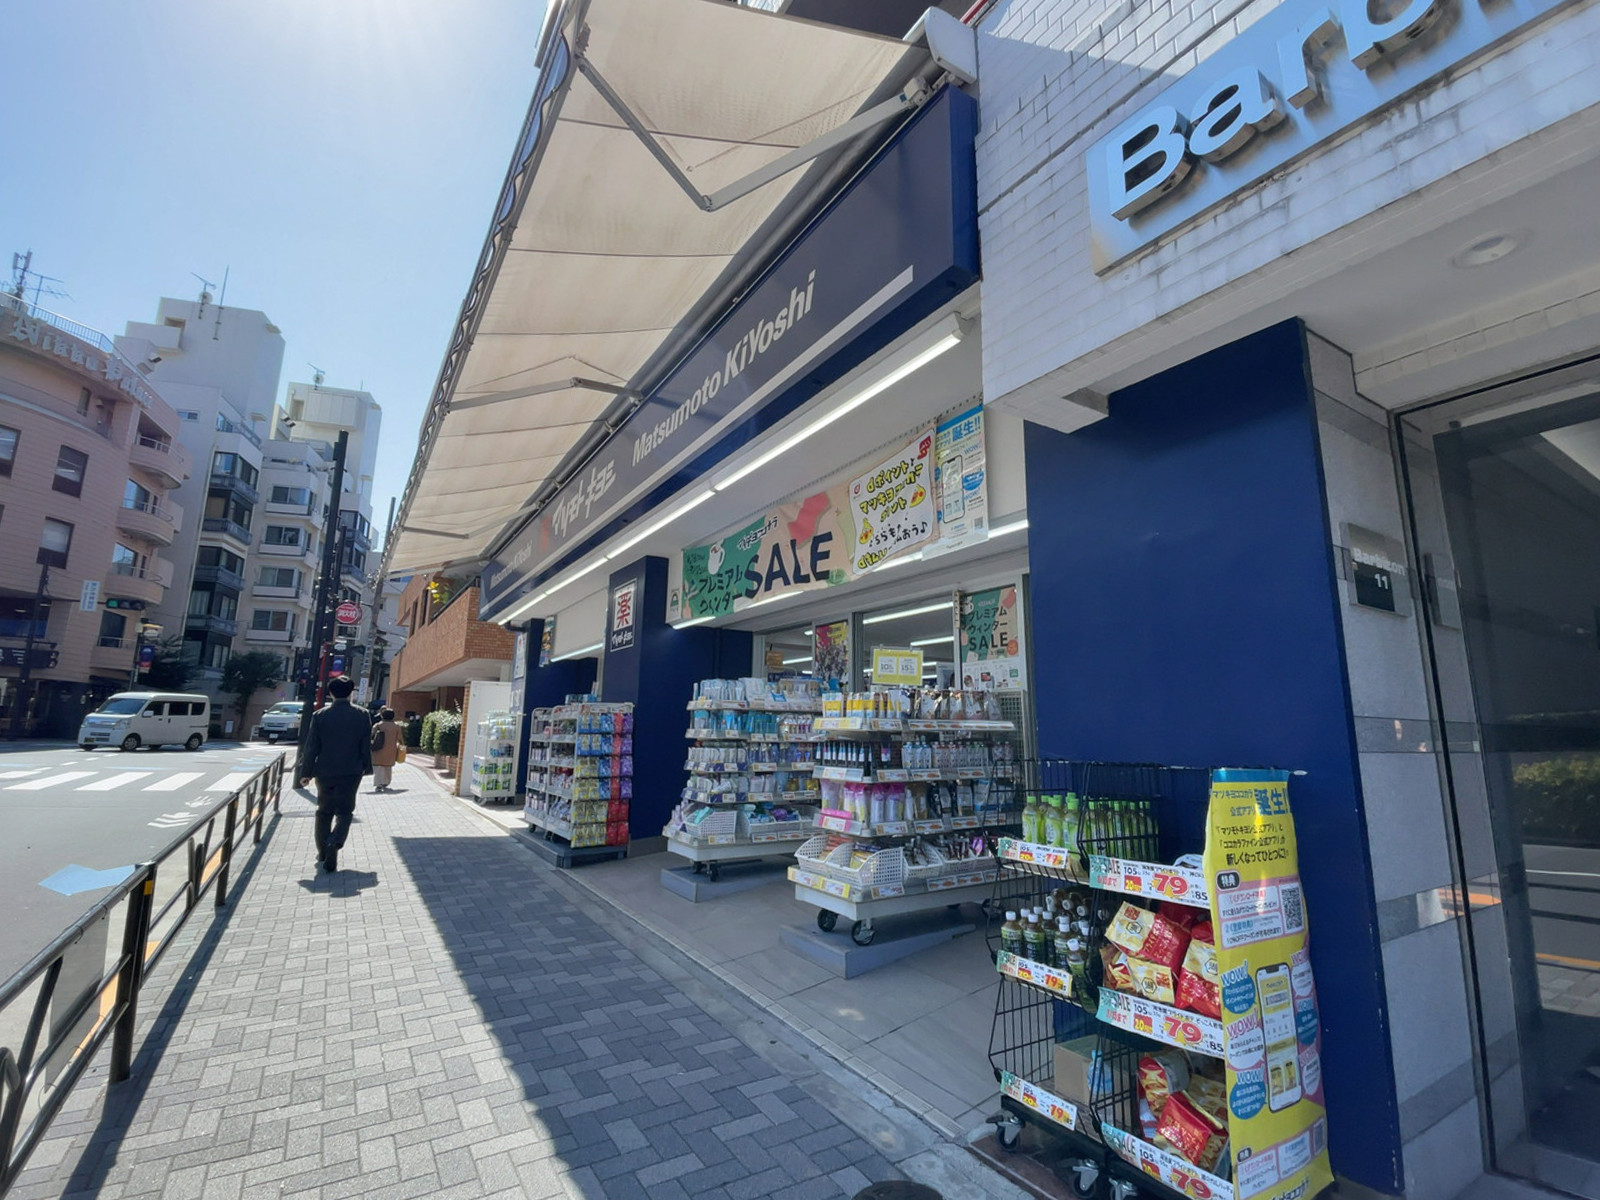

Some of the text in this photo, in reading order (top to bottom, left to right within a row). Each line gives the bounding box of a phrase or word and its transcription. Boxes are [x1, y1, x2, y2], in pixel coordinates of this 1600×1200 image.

[632, 269, 816, 467] Matsumoto KiYoshi
[744, 531, 833, 599] SALE
[1374, 573, 1388, 590] 11
[616, 590, 632, 629] 薬
[968, 632, 1009, 651] SALE
[1153, 873, 1189, 896] 79
[1195, 892, 1208, 901] 85
[1164, 1016, 1203, 1044] 79
[1209, 1042, 1224, 1053] 85
[1171, 1168, 1212, 1199] 79
